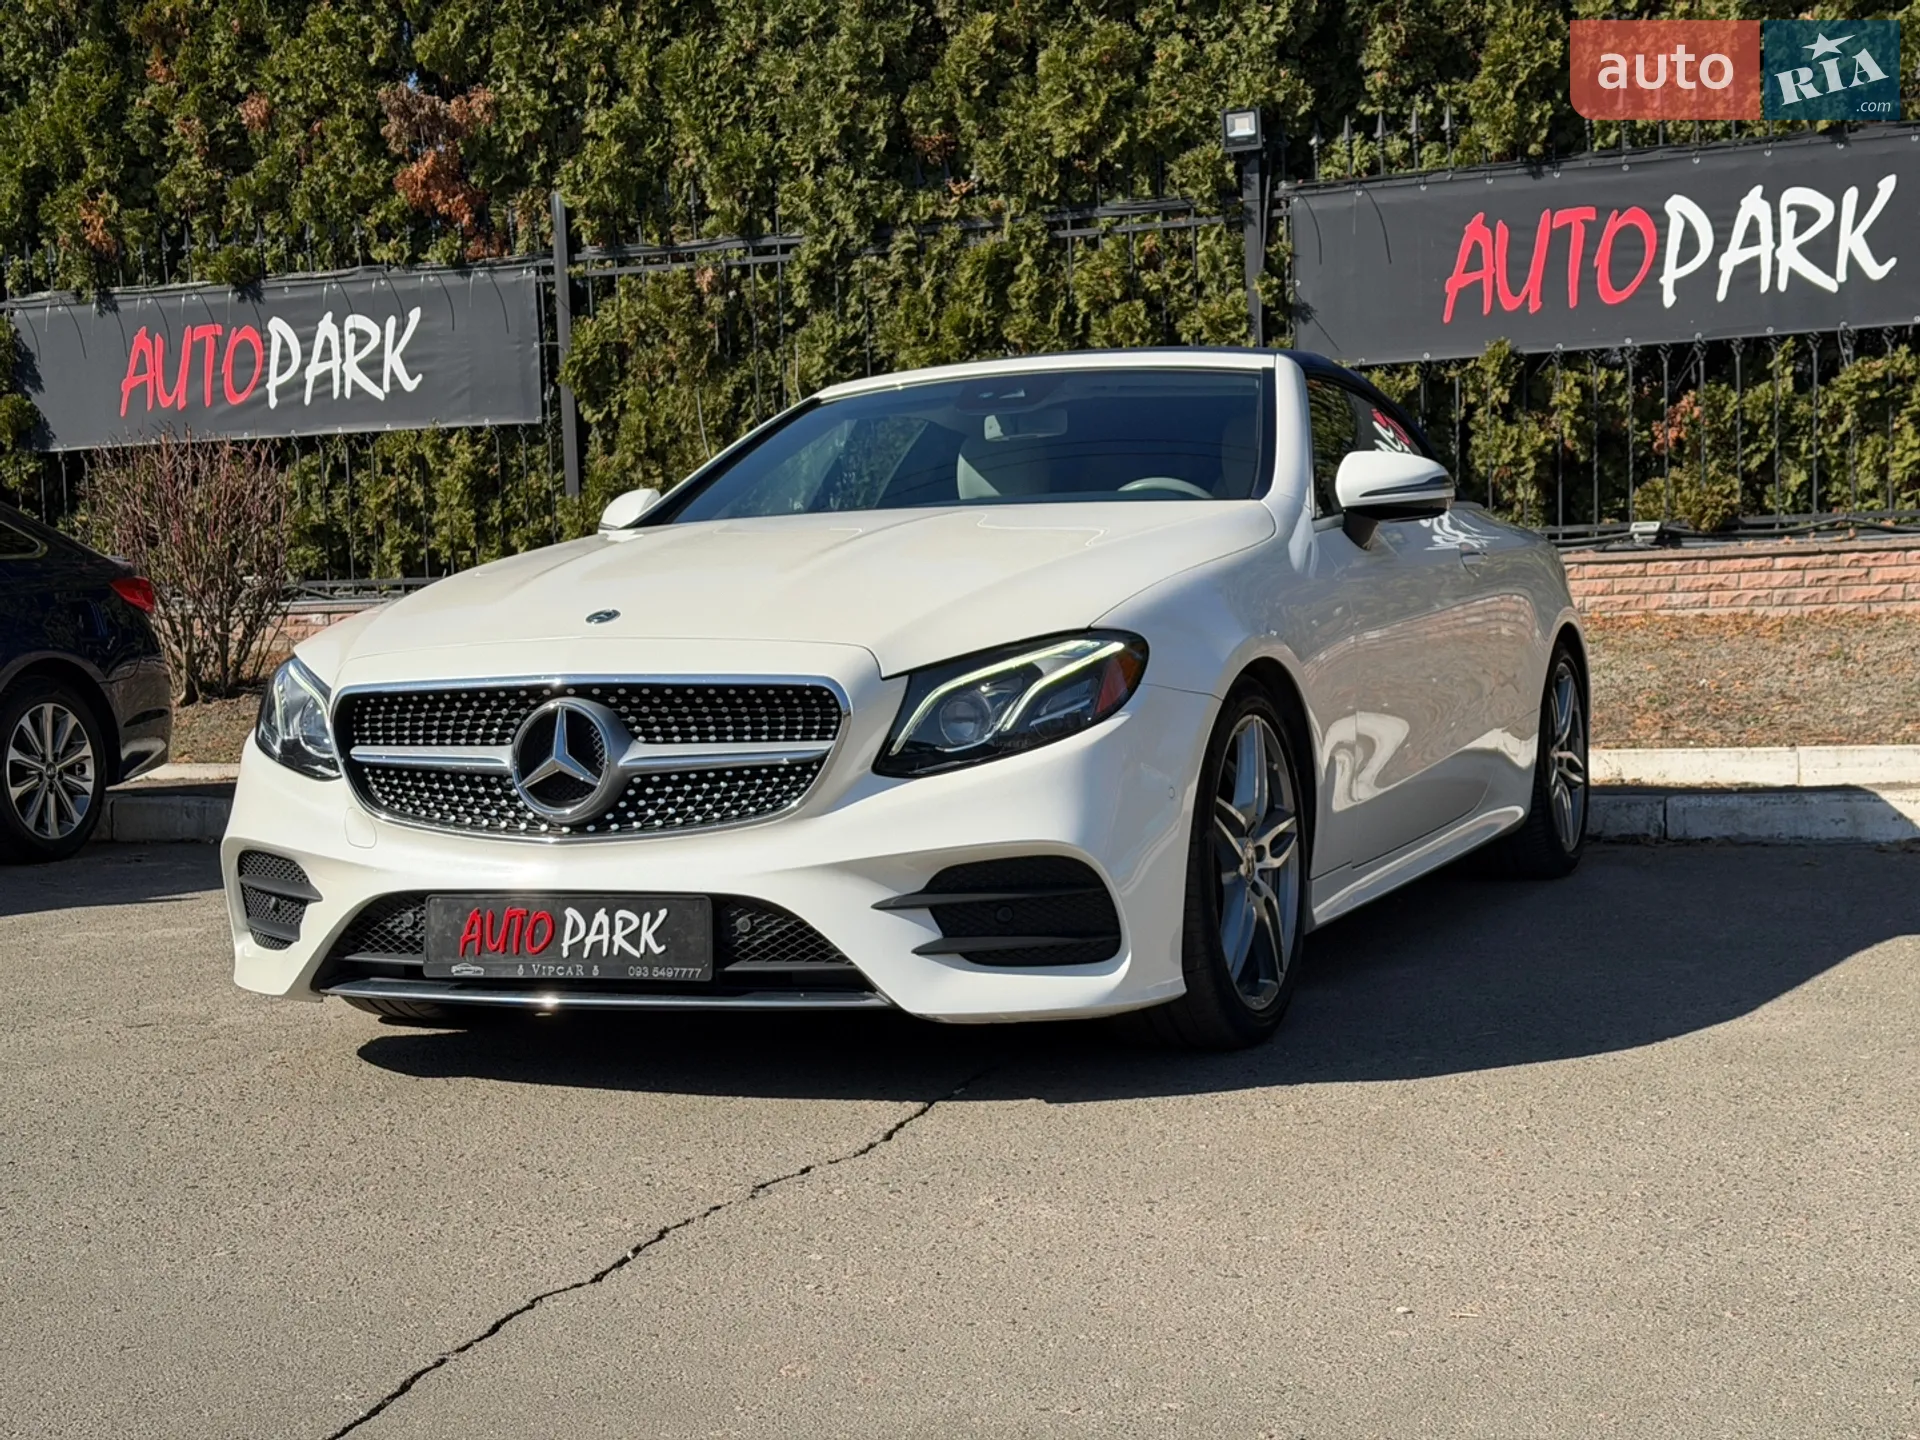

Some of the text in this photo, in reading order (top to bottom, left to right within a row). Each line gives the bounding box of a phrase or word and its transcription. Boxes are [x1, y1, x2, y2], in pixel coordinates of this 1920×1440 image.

[460, 906, 668, 958] AUTO PARK
[531, 964, 584, 976] VIPCAR
[628, 966, 702, 979] 093 5497777
